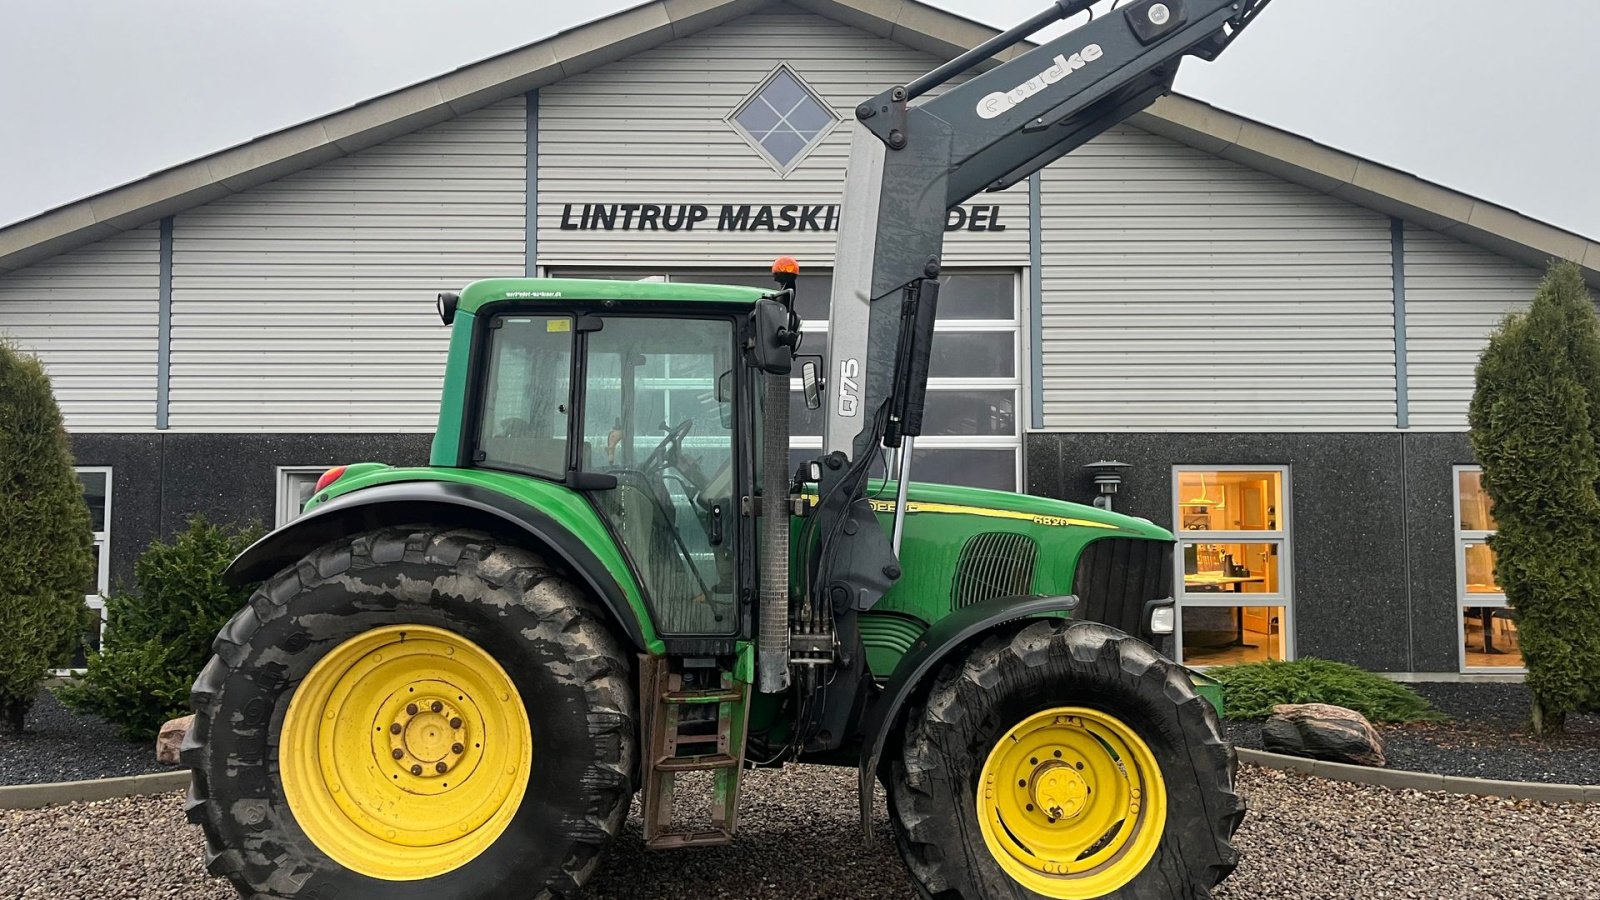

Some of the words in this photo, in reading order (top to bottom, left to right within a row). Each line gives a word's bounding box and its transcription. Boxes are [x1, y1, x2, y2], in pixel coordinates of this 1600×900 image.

[560, 204, 708, 231] LINTRUP
[838, 357, 859, 417] Q75
[1033, 514, 1069, 526] 6820
